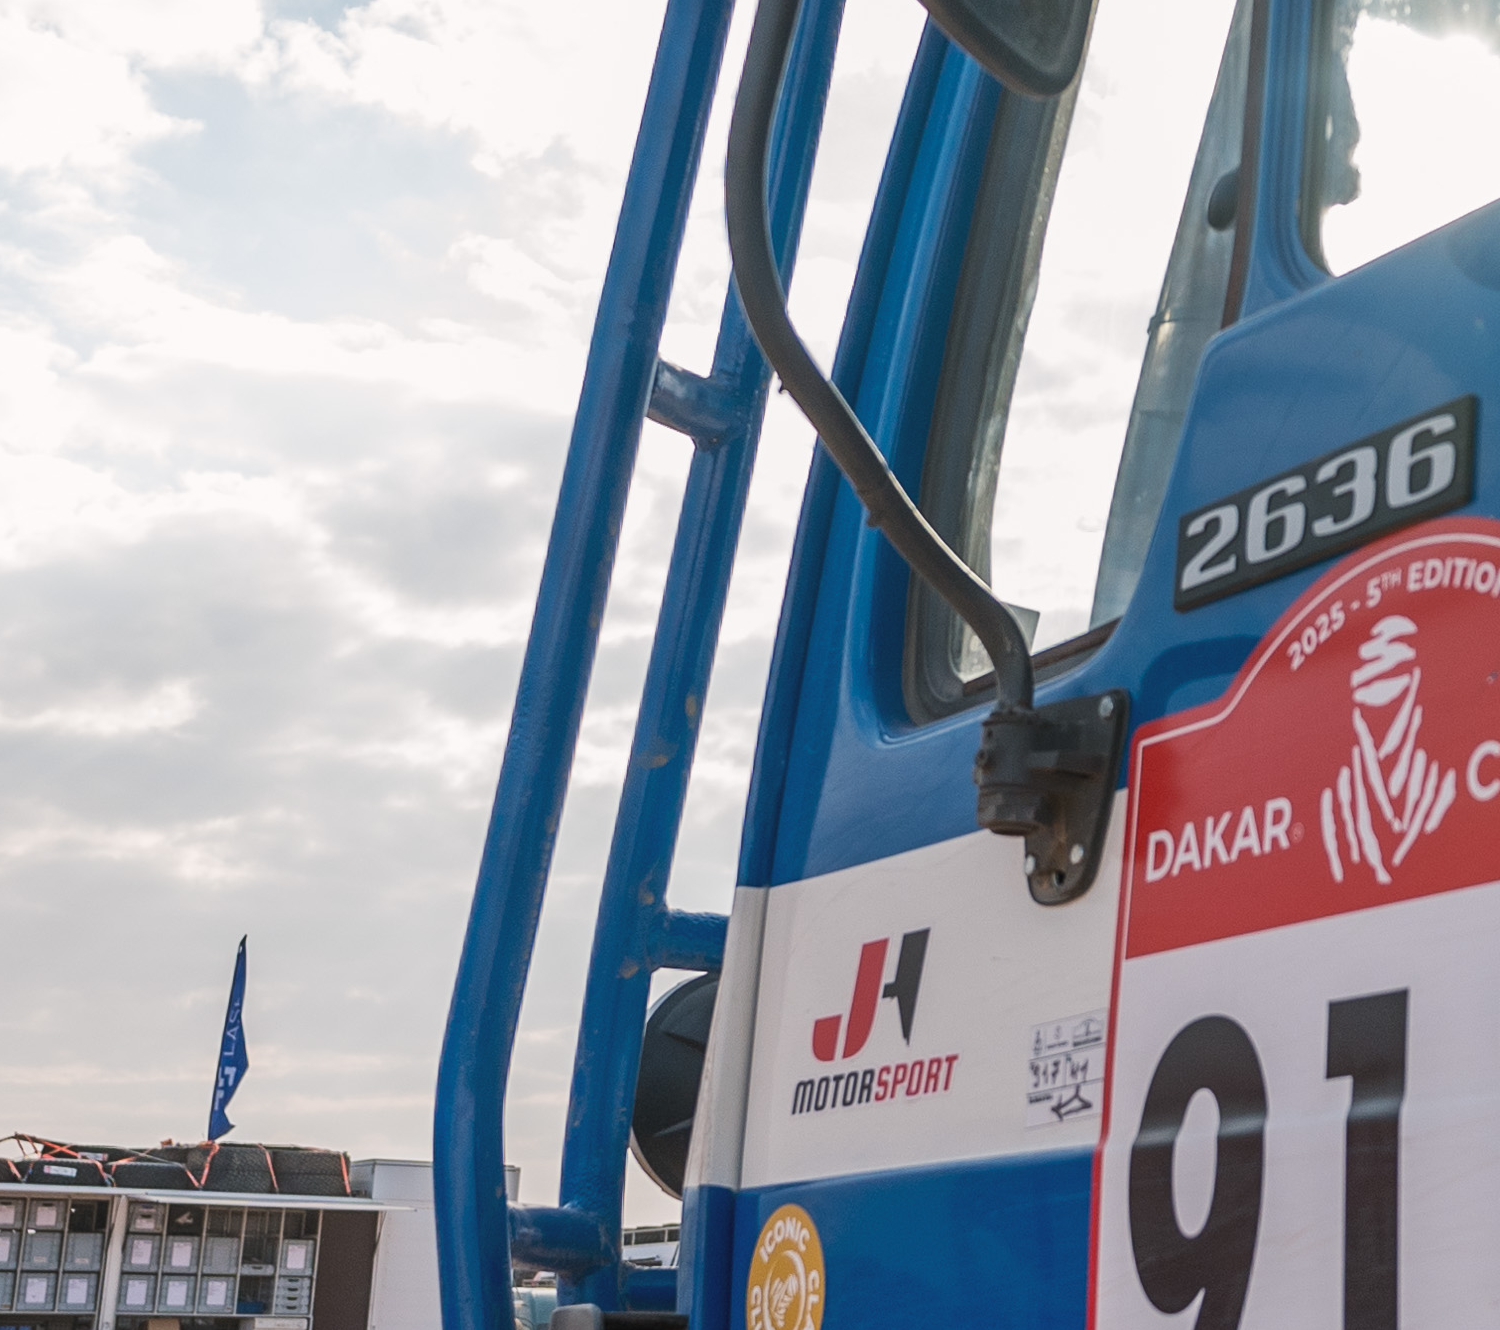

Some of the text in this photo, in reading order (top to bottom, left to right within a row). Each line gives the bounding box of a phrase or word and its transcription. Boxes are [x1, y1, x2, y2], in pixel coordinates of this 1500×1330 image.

[1181, 414, 1456, 591] 2636
[1286, 609, 1345, 671] 2025
[1145, 797, 1294, 883] DAKAR
[792, 1054, 958, 1115] MOTORSPORT
[759, 1216, 810, 1264] ICONIC
